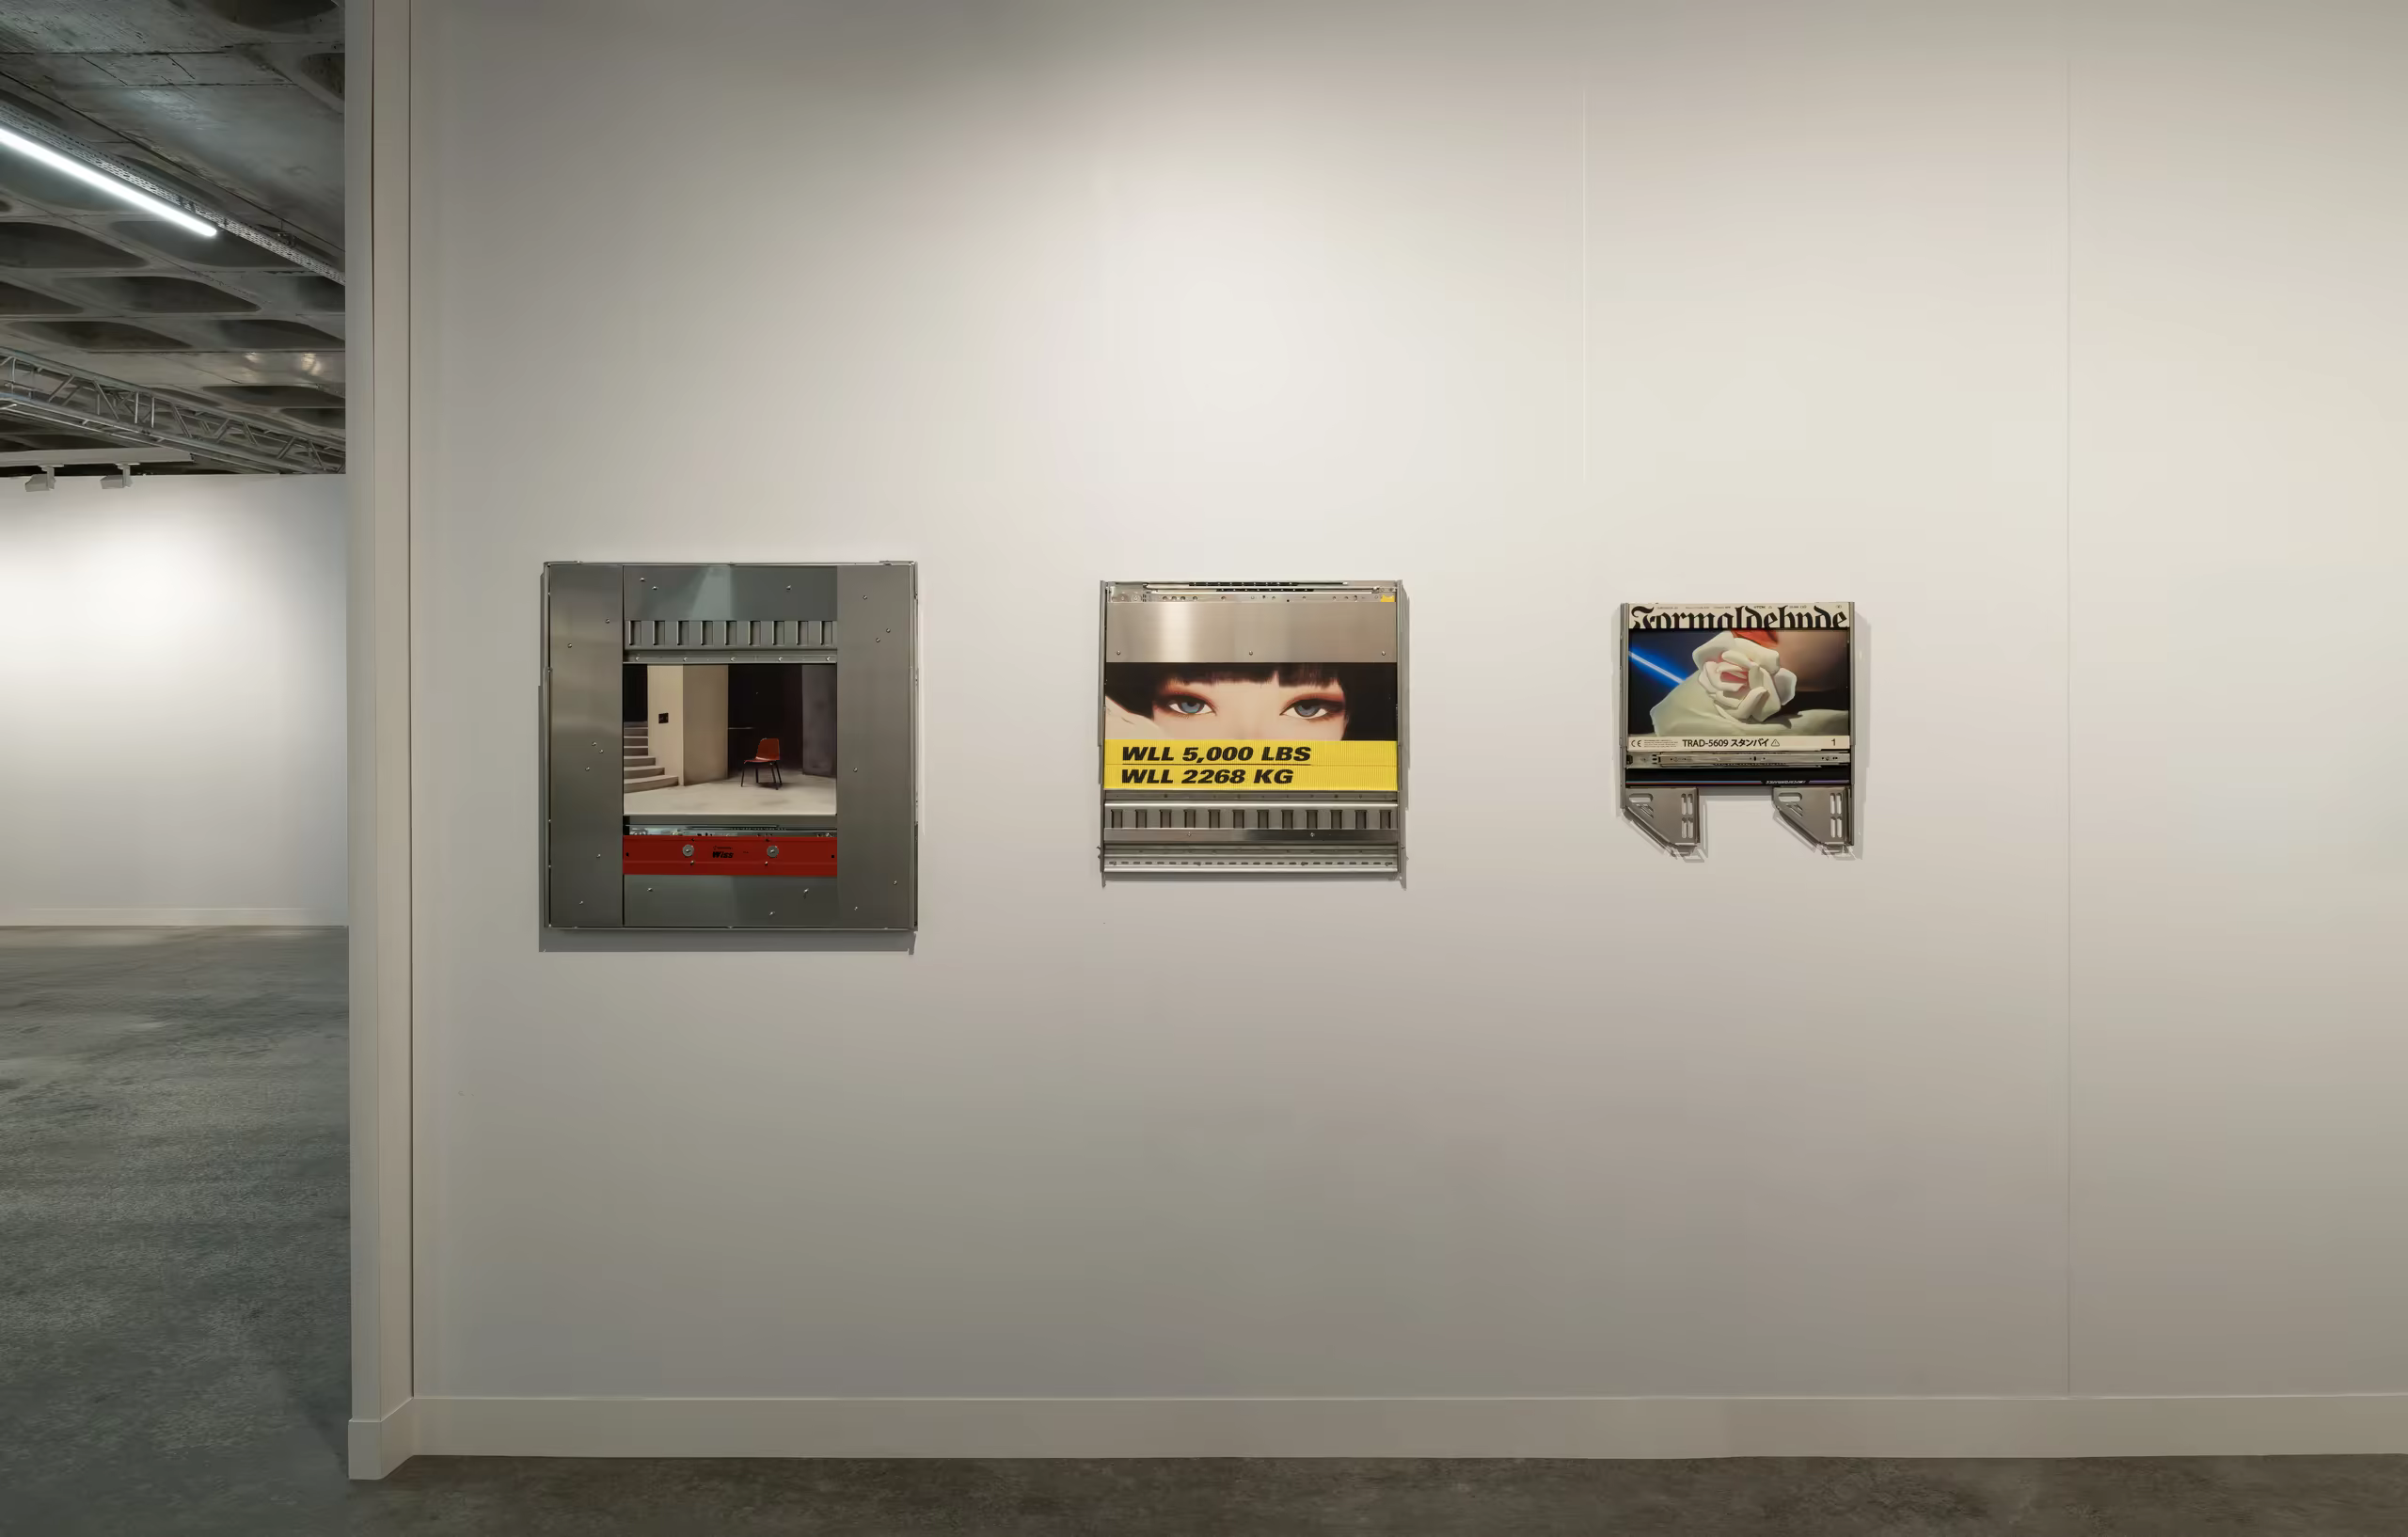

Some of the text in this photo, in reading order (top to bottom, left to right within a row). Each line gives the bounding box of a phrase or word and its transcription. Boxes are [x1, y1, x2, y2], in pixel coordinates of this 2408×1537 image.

[1682, 738, 1729, 748] TRAD-5609
[1731, 737, 1769, 747] スタンバイ
[1122, 746, 1311, 764] WLL 5,000 LBS
[1121, 768, 1294, 784] WLL 2268 KG
